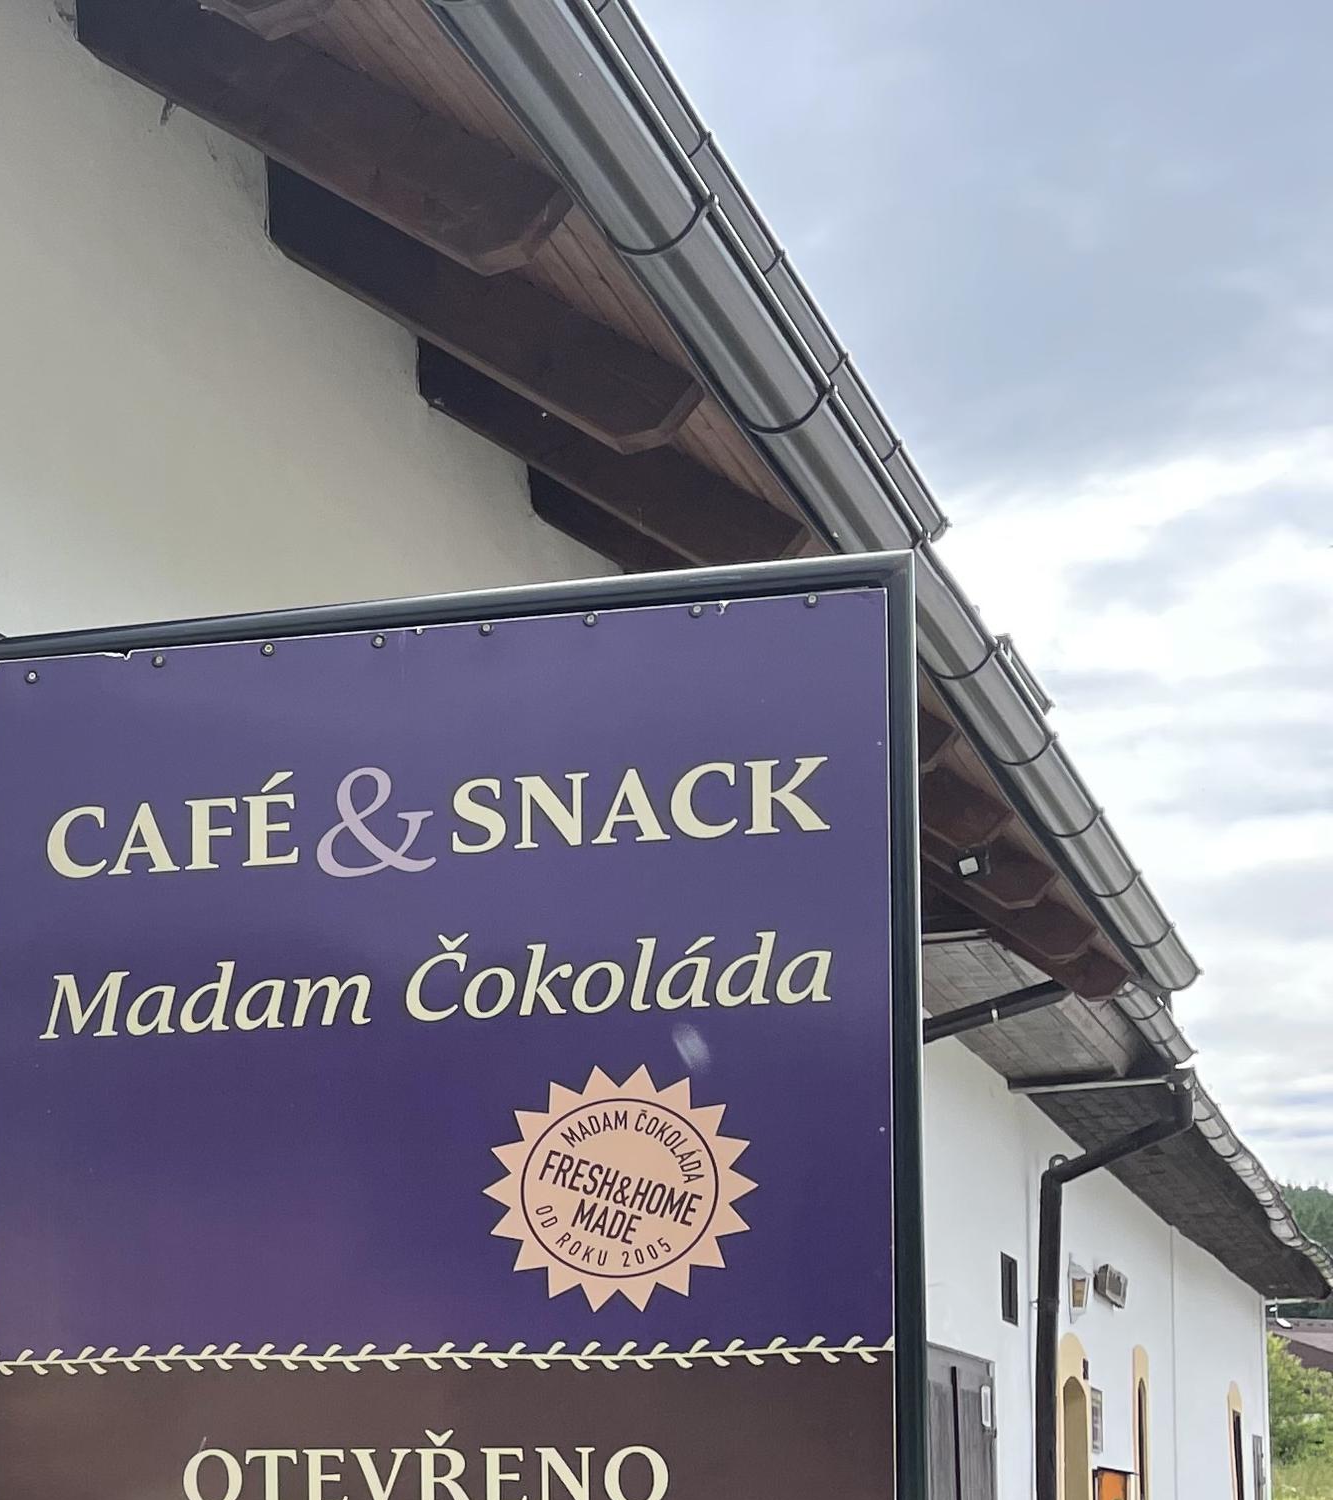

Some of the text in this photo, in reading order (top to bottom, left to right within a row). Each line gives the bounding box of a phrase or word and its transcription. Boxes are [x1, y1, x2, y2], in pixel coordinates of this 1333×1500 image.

[46, 756, 831, 879] CAFÉ & SNACK
[39, 931, 832, 1039] Madam Čokoláda
[560, 1109, 705, 1185] MADAM ČOKOLÁDA
[538, 1149, 703, 1227] FRESH&HOME
[570, 1198, 643, 1245] MADE
[535, 1204, 672, 1268] OD ROKU 2005
